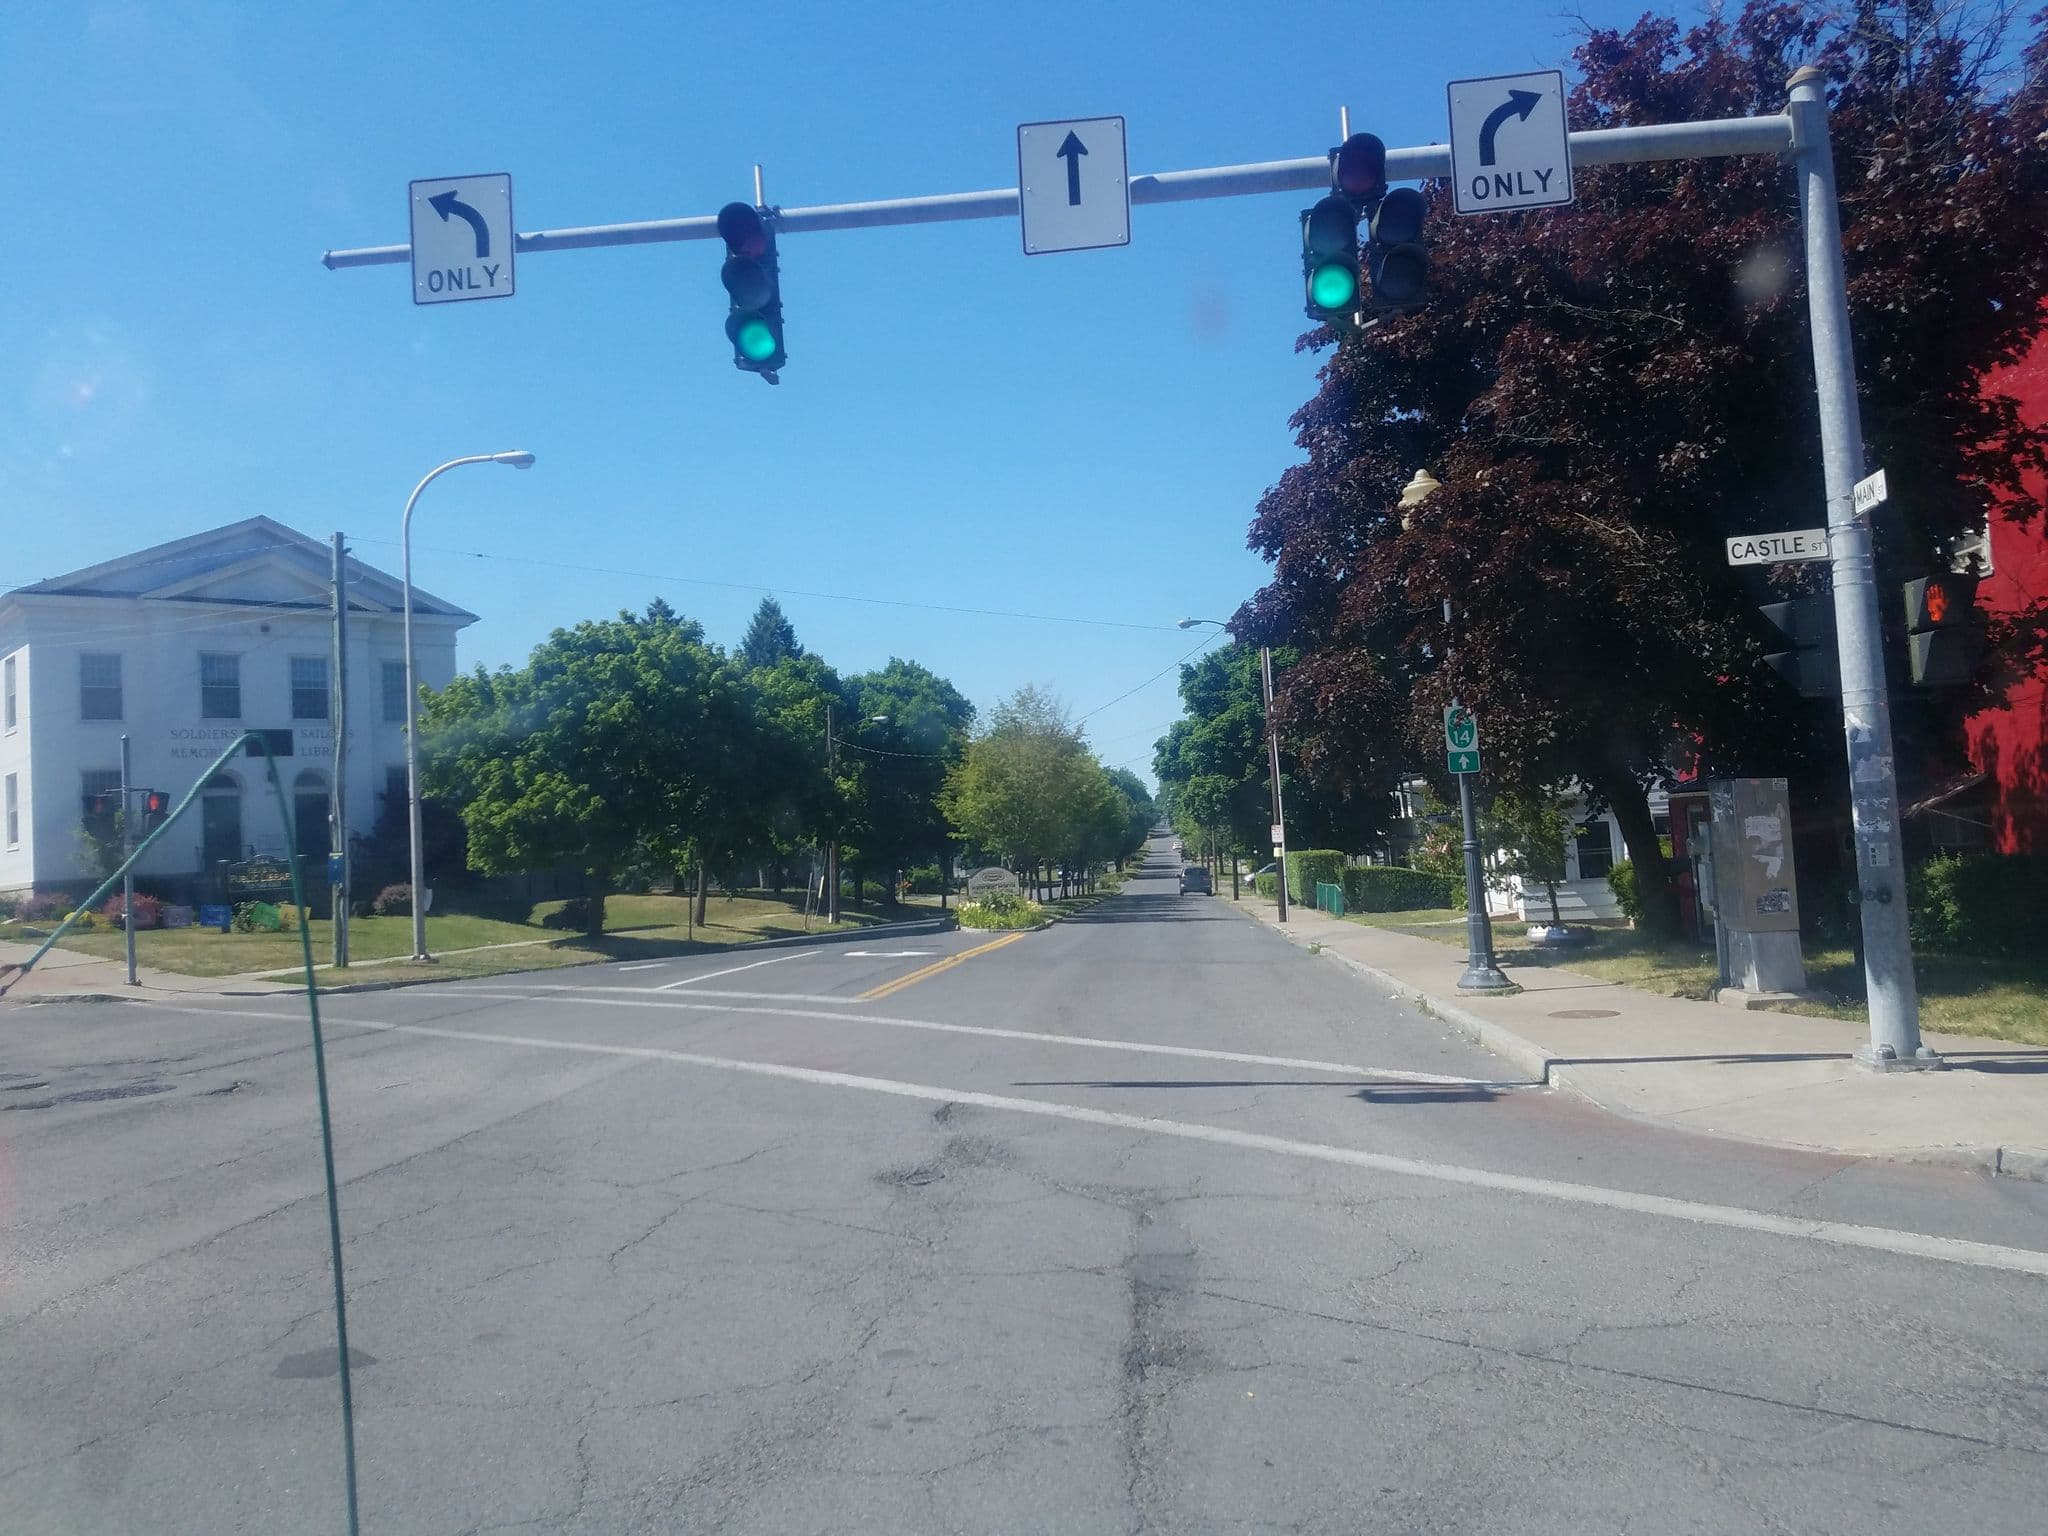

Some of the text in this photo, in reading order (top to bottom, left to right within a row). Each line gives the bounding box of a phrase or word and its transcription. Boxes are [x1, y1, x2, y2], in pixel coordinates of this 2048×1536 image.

[1472, 168, 1553, 200] ONLY
[428, 264, 500, 293] ONLY
[1855, 481, 1875, 505] MAIN
[1731, 536, 1823, 559] CASTLE ST
[170, 728, 354, 739] SOLDIERS SAILS
[1453, 729, 1470, 744] 14
[170, 746, 353, 758] MEMORIL LIBR
